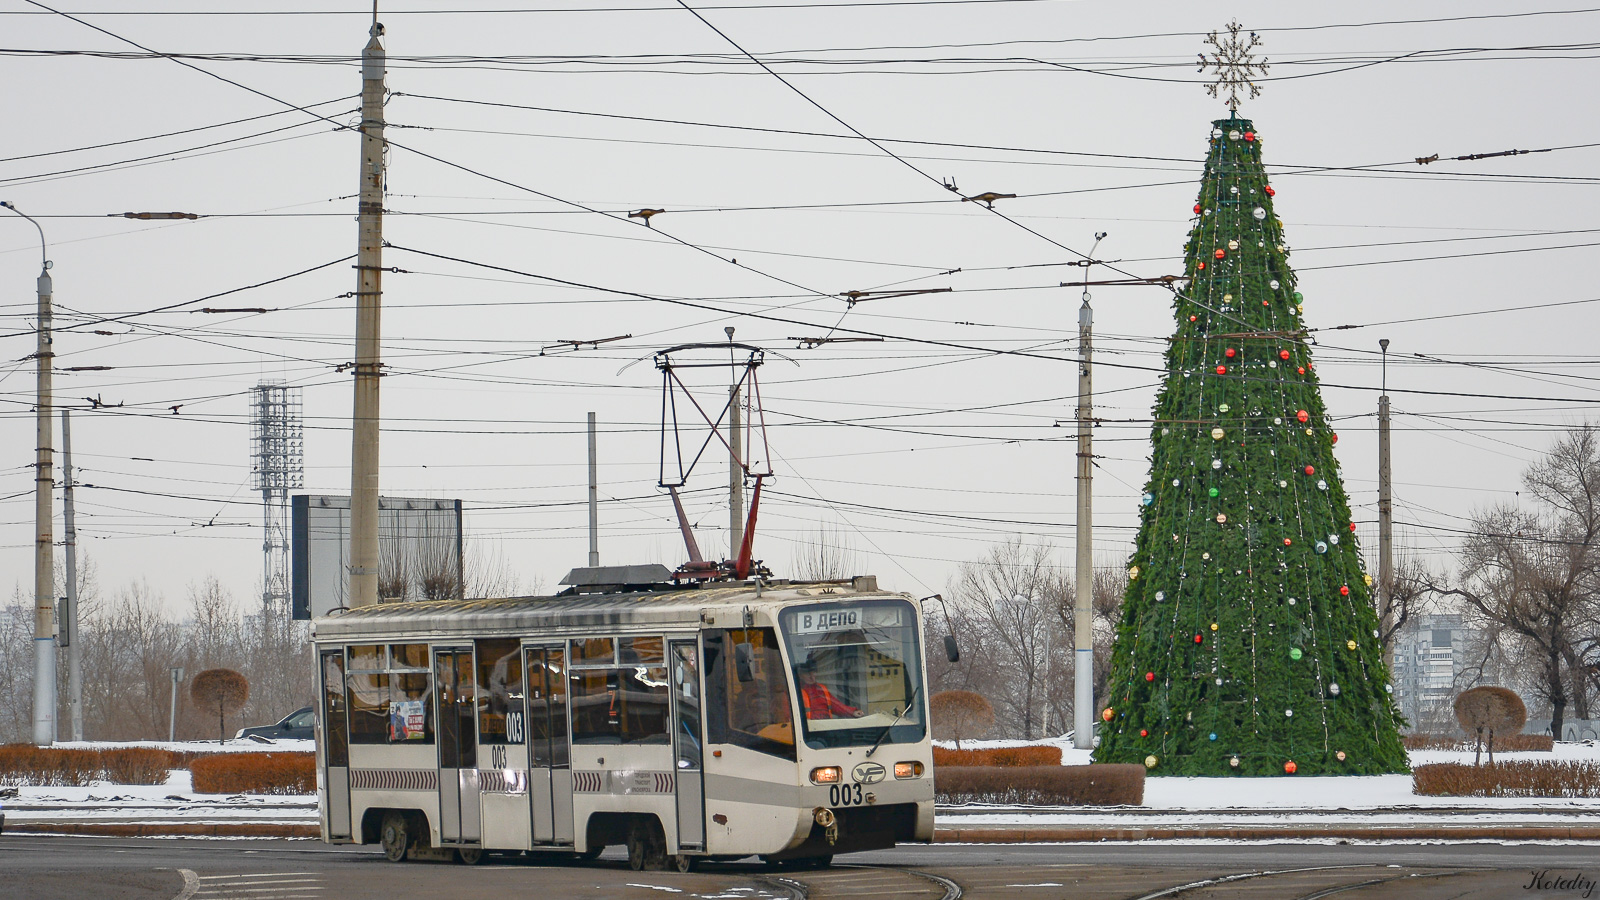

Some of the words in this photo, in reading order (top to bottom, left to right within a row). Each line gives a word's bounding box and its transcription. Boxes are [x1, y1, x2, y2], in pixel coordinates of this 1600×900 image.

[803, 614, 813, 629] В
[816, 611, 857, 630] ДЕПО
[506, 712, 523, 742] 003
[492, 745, 507, 769] 003
[829, 782, 863, 806] 003
